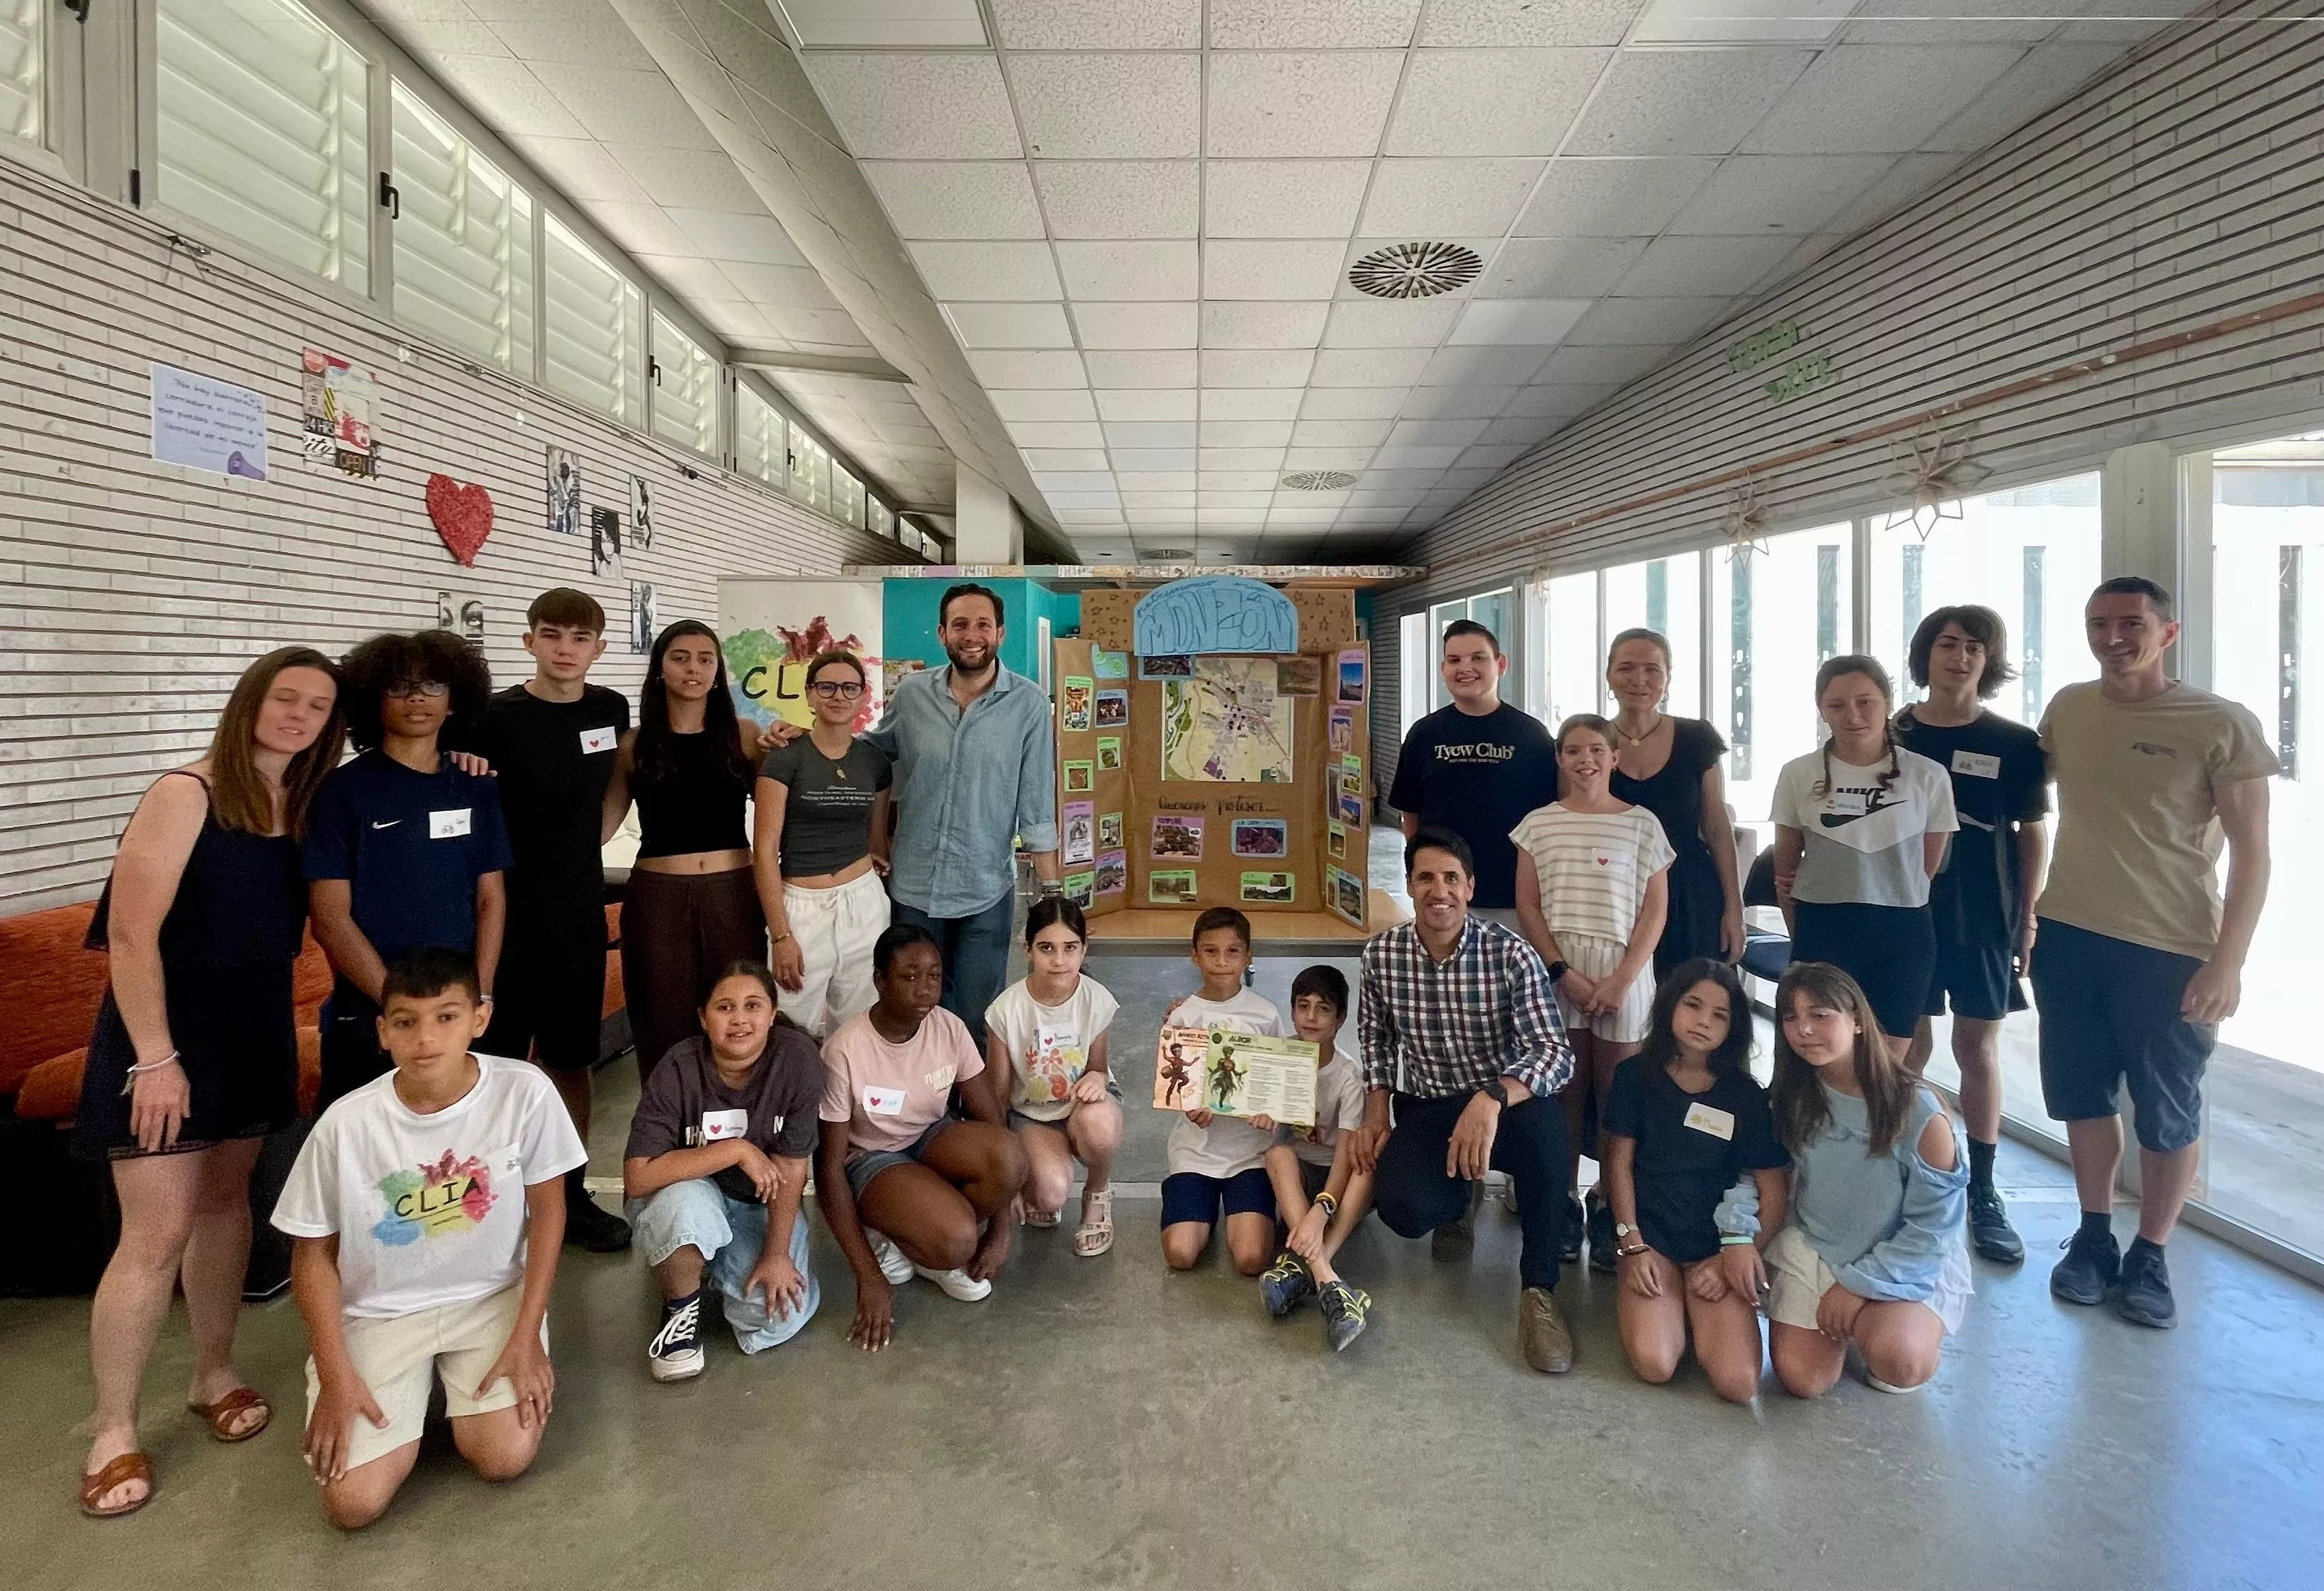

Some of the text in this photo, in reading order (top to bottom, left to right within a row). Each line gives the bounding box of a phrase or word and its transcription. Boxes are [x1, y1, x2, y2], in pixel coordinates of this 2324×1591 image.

[741, 664, 800, 700] CL
[1476, 743, 1513, 760] Club
[394, 1177, 483, 1217] CLIA
